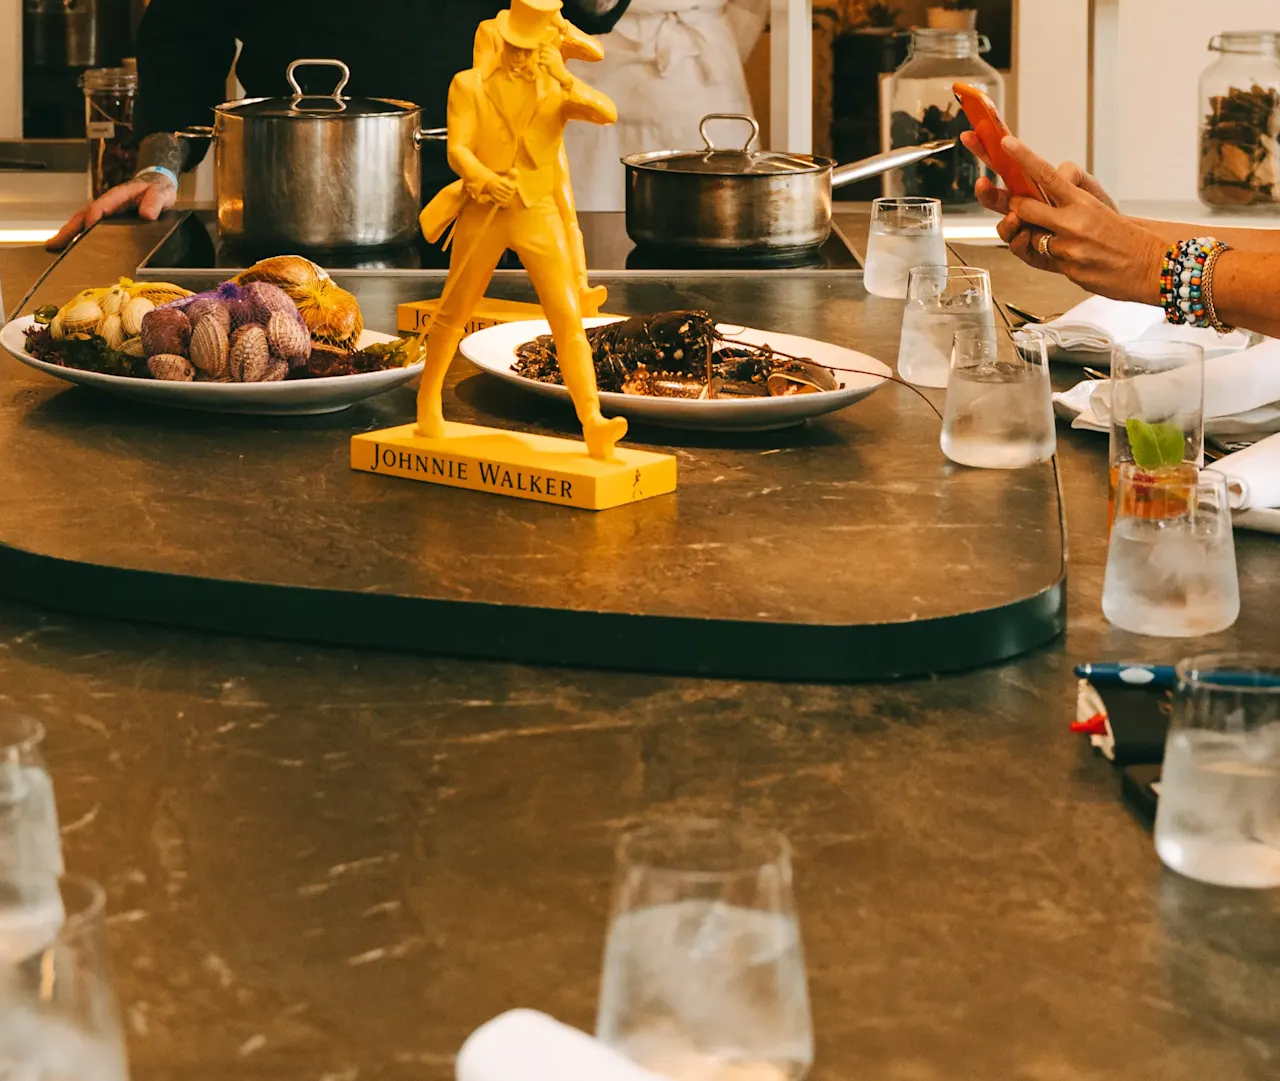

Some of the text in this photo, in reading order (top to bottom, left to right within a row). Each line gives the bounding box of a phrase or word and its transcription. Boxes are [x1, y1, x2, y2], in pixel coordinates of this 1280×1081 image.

[412, 309, 486, 334] JOIE
[370, 443, 573, 499] JOHNNIE WALKER
